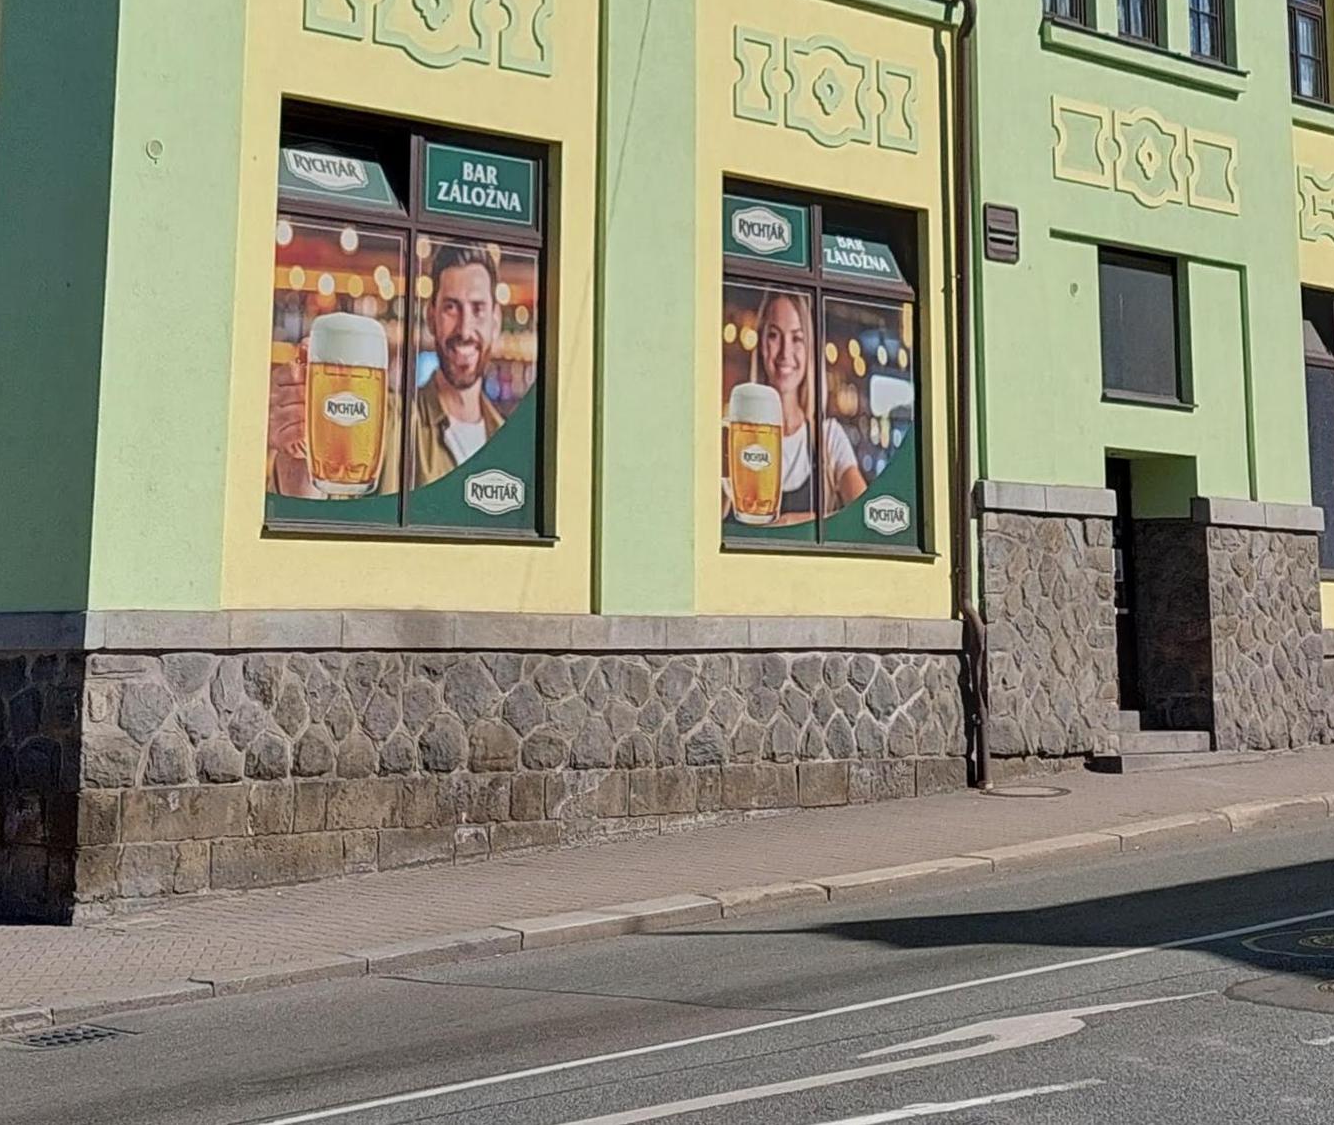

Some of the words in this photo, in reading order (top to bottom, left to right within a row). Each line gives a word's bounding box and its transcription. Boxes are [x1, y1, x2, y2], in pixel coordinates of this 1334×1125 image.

[292, 153, 364, 184] RYCHTÁŘ
[462, 161, 498, 185] BAR
[437, 179, 522, 212] ZÁLOŽNA
[738, 218, 787, 245] RYCHTÁŘ
[823, 247, 891, 272] ZÁLOŽNA
[471, 481, 521, 504] RYCHTÁŘ
